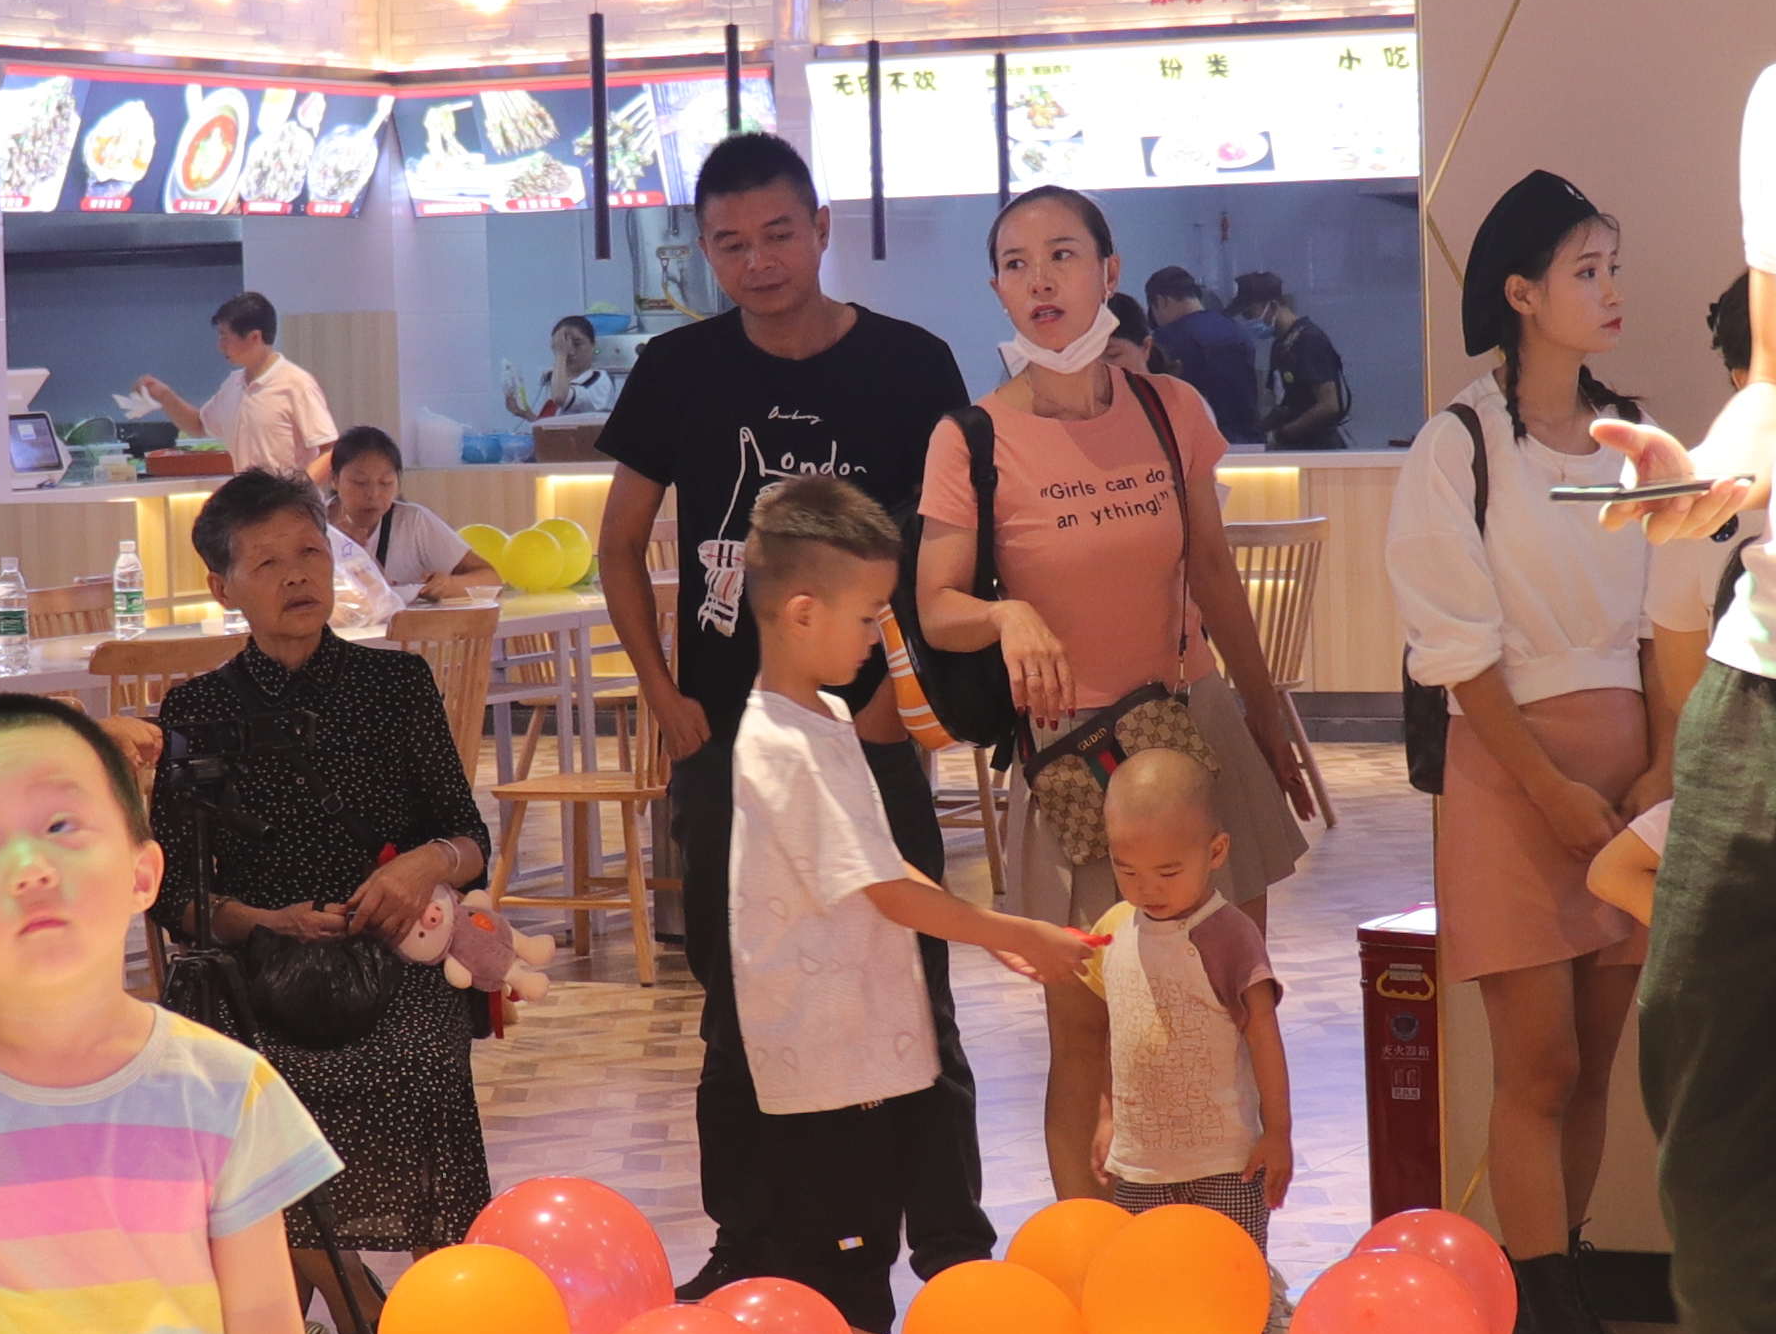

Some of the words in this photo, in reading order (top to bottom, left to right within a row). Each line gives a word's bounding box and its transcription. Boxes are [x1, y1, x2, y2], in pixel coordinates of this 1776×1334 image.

[1159, 53, 1231, 80] 粉类
[1337, 45, 1410, 72] 小吃
[1105, 476, 1138, 492] can
[1145, 468, 1165, 484] do
[1057, 514, 1079, 529] an
